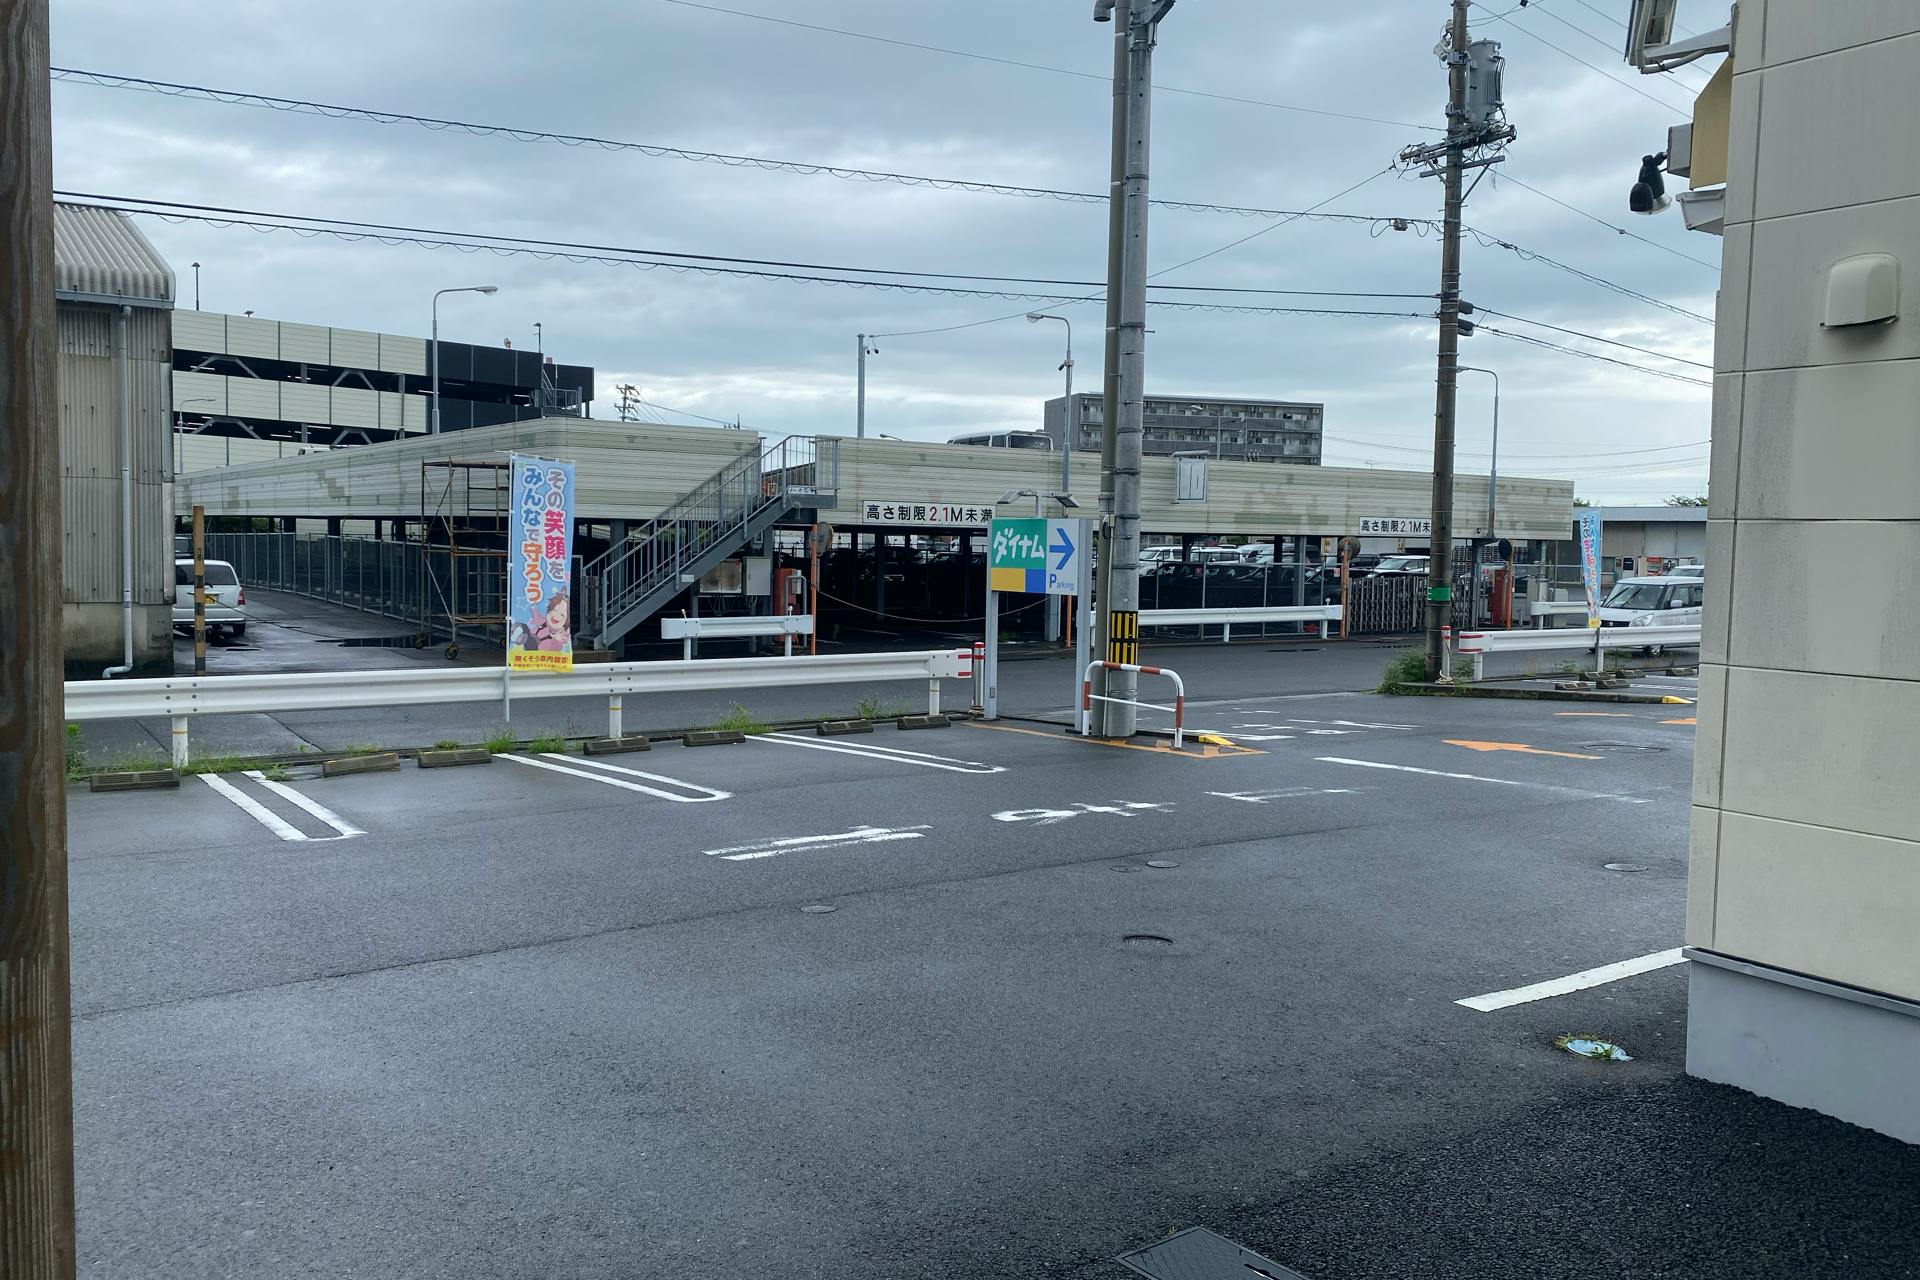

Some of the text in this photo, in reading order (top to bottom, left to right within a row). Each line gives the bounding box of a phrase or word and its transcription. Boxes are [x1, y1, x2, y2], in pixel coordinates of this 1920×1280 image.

[522, 467, 543, 603] みんなで守ろう
[544, 470, 566, 580] その笑顔を
[866, 504, 993, 523] 高さ制限2.1M未満
[993, 527, 1045, 564] ダイナム
